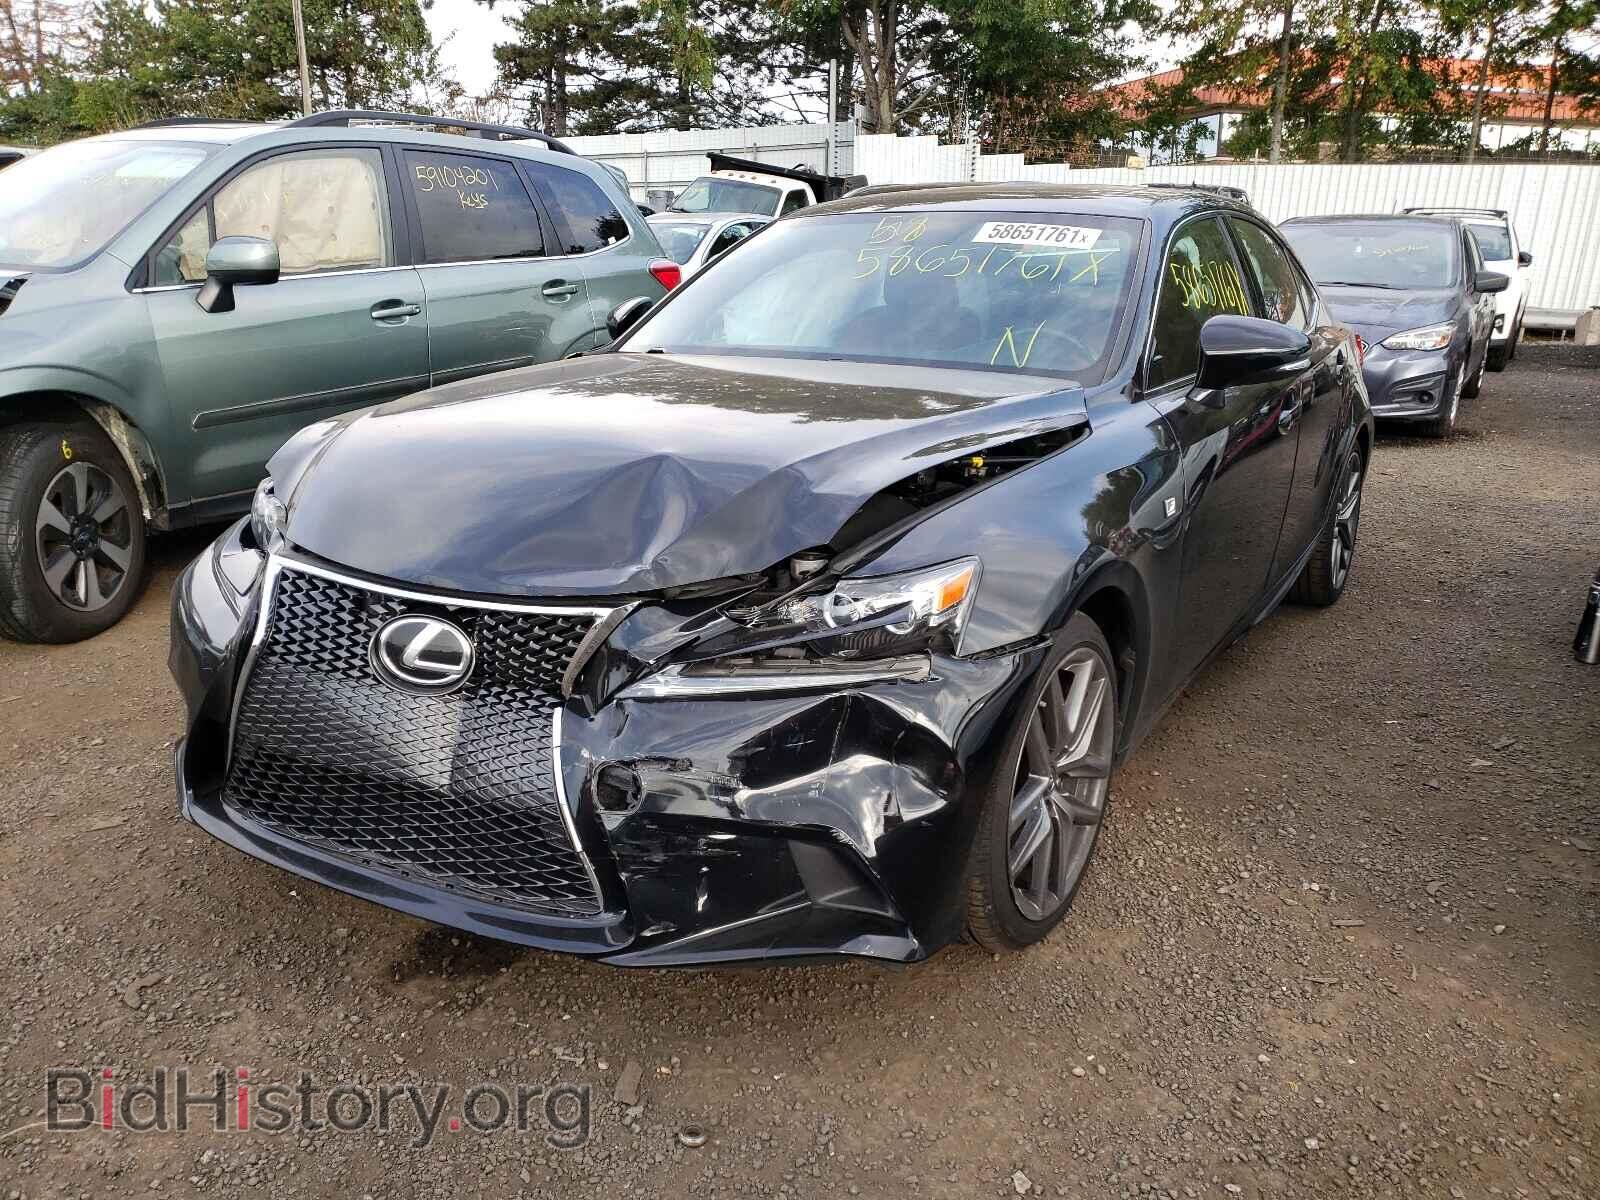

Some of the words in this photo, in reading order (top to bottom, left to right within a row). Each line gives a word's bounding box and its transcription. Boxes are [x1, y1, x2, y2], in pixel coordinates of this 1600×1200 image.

[415, 165, 499, 192] 59104201
[990, 319, 1048, 368] N
[61, 439, 72, 460] 6
